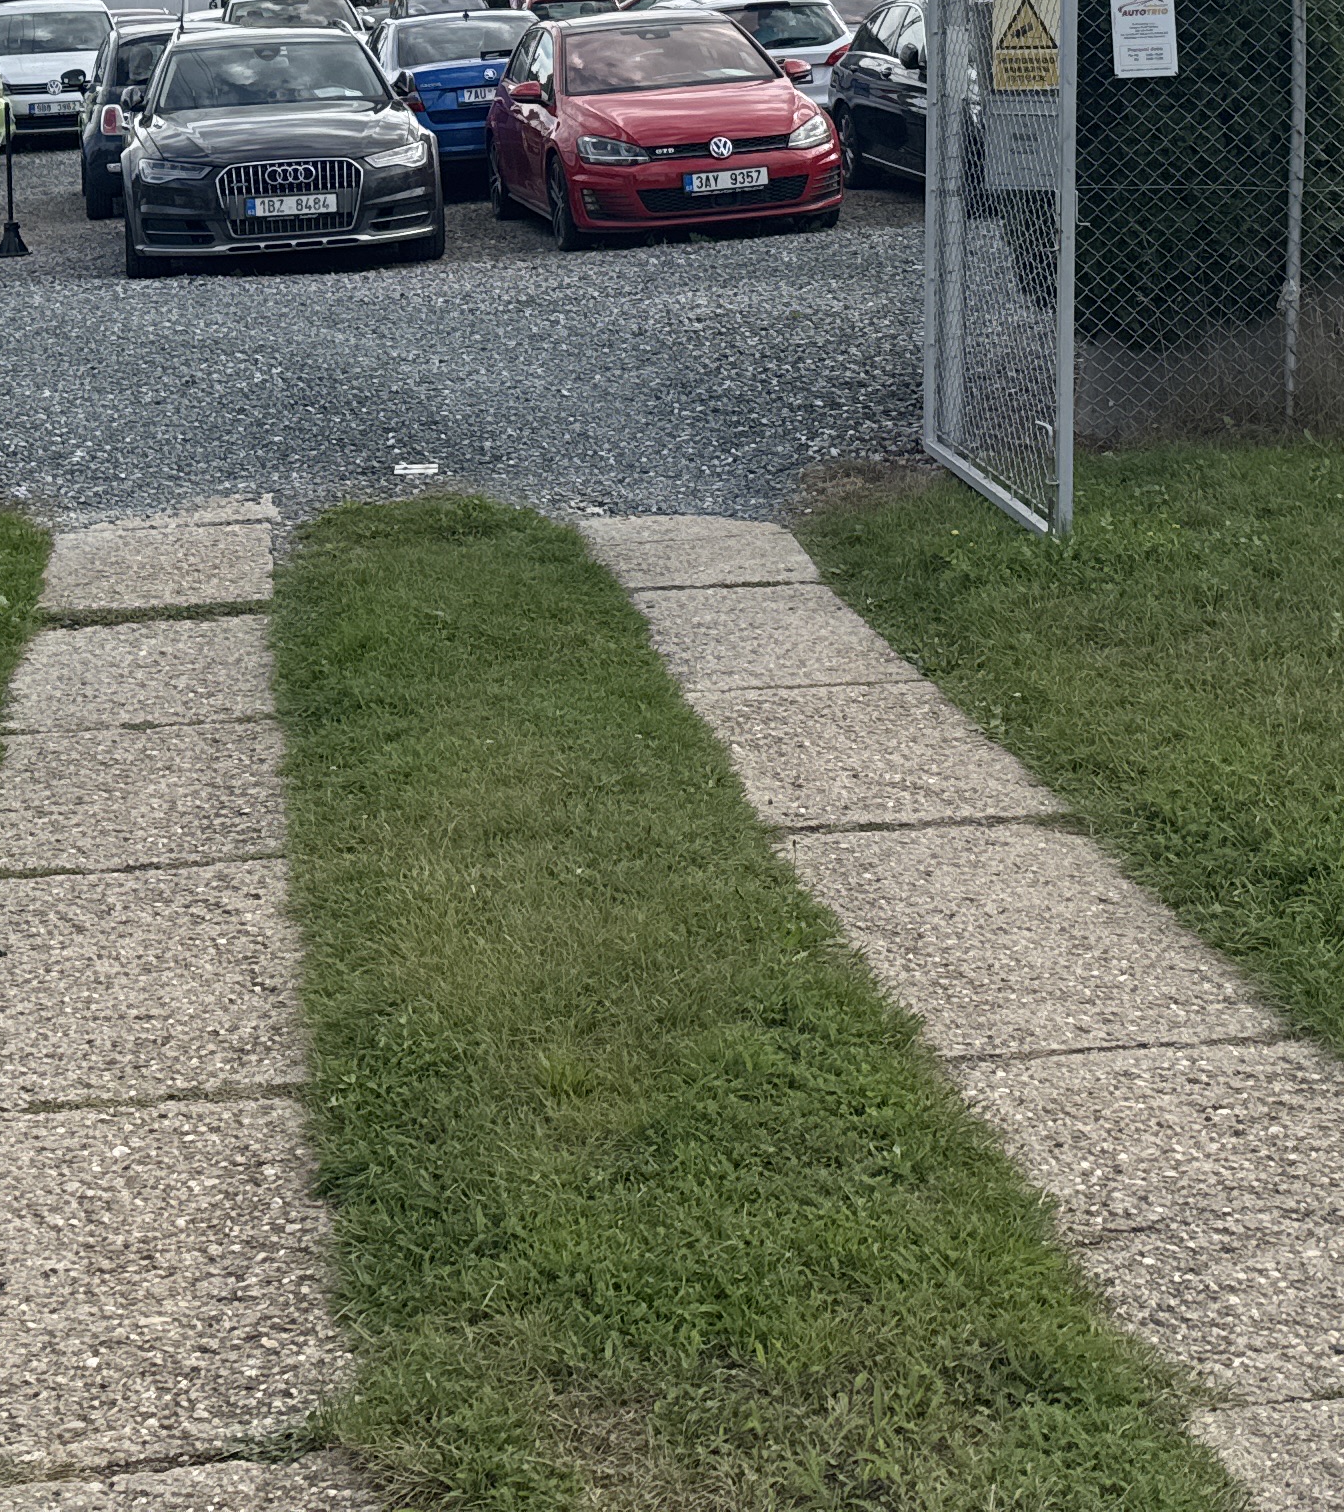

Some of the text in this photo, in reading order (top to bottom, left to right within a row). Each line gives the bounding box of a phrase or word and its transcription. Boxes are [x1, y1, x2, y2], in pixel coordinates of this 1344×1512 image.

[466, 89, 486, 101] 7AU
[696, 169, 762, 189] 3AY 9357
[260, 196, 330, 214] 1BZ 8484
